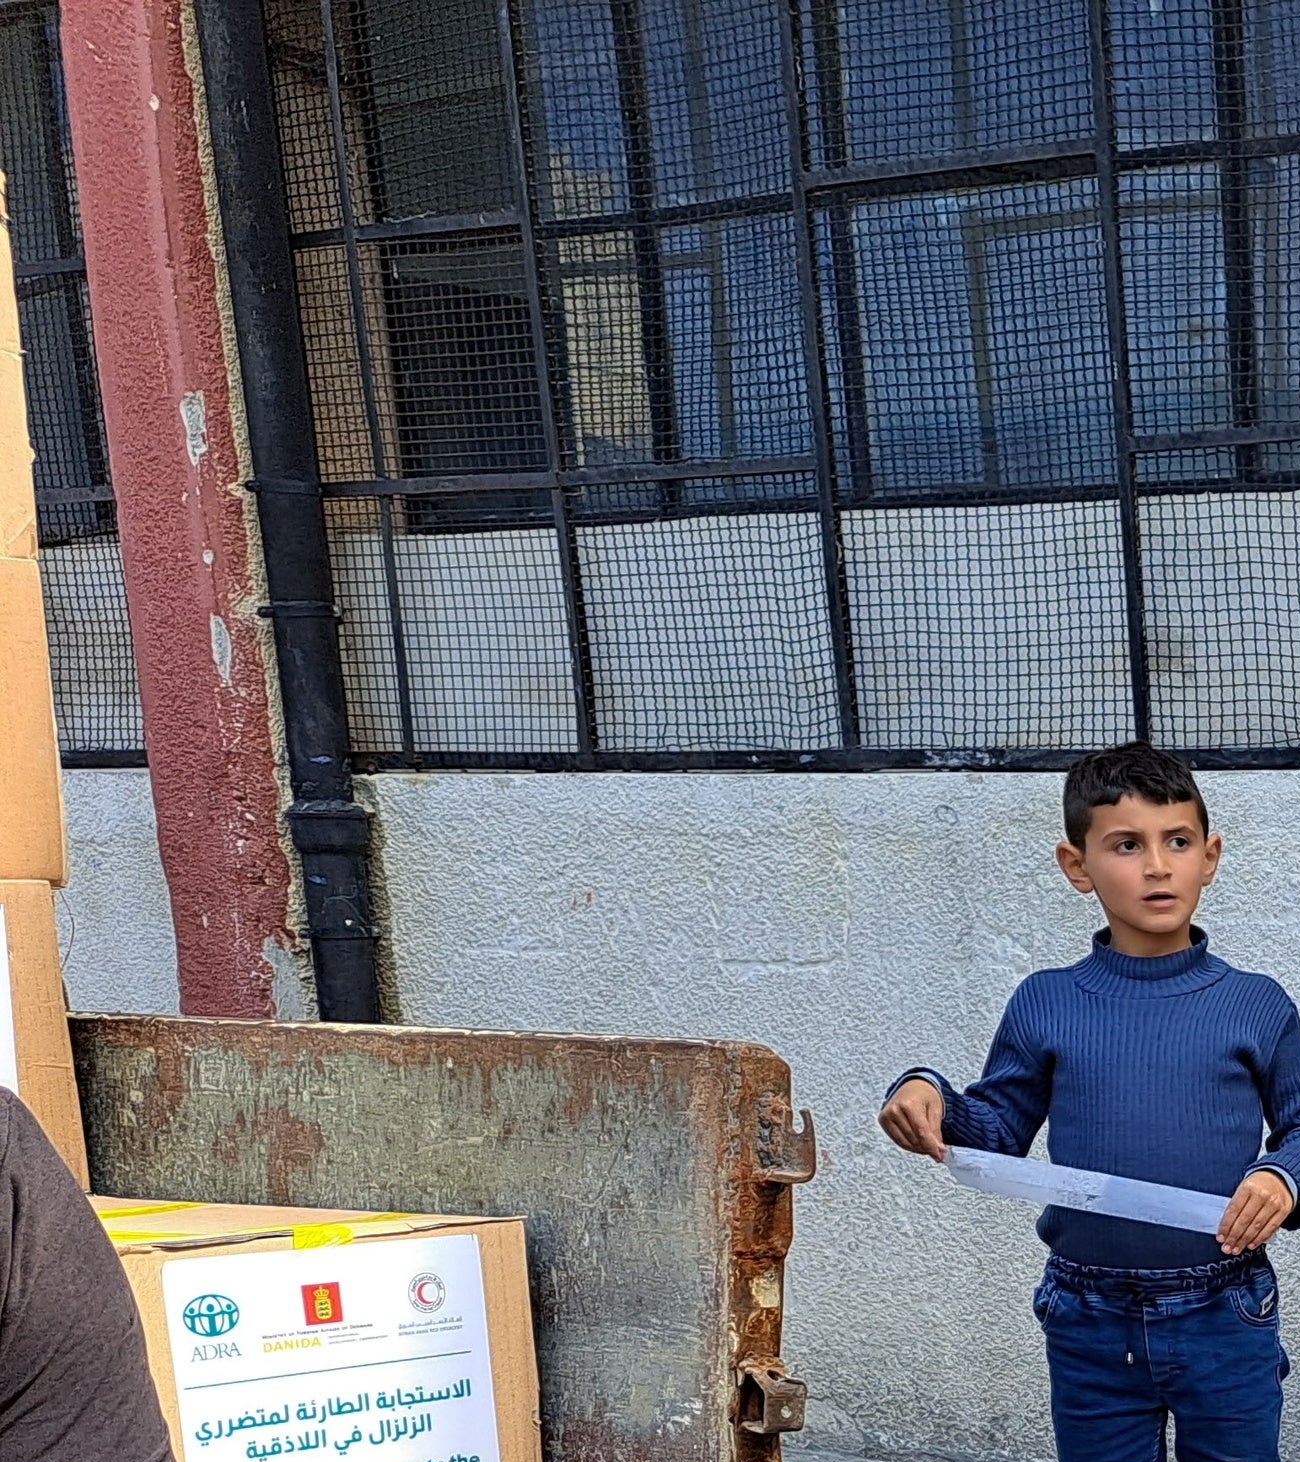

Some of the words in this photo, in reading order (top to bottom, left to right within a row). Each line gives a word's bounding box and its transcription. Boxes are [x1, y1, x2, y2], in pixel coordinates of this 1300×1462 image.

[191, 1342, 242, 1363] ADRA
[263, 1336, 322, 1354] DANIDA
[296, 1393, 370, 1424] الطارئة
[375, 1378, 472, 1411] الاستجابة
[194, 1404, 290, 1447] لمتضرري
[333, 1425, 363, 1456] في
[369, 1413, 432, 1445] الزلزال
[246, 1429, 327, 1462] اللاذقية
